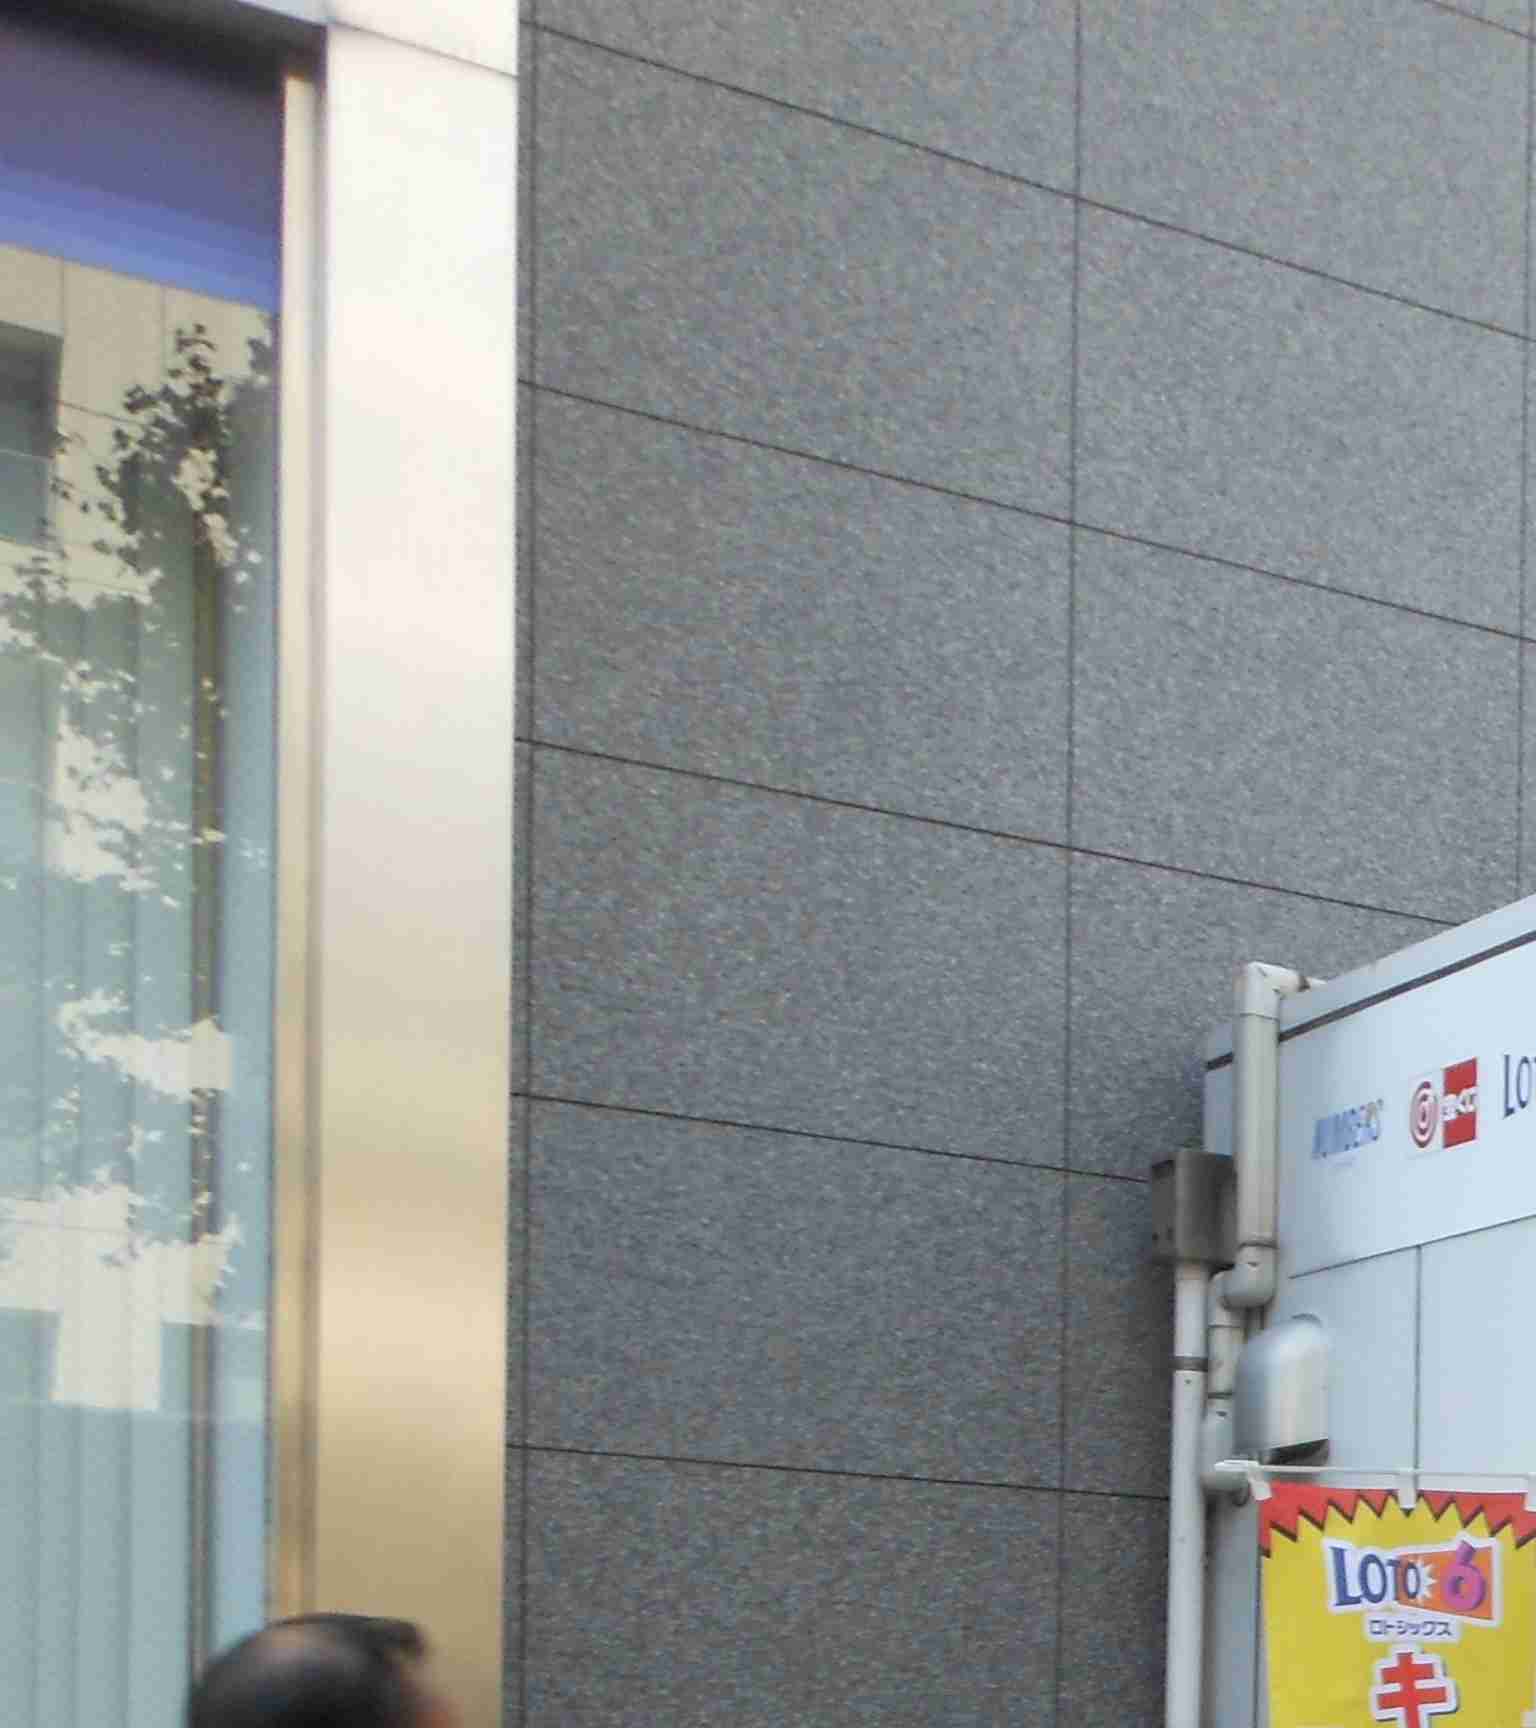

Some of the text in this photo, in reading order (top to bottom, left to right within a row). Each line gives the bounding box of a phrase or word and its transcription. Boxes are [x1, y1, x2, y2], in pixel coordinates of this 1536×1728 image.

[1331, 1546, 1421, 1606] LOTO
[1369, 1618, 1454, 1637] ロトシックス
